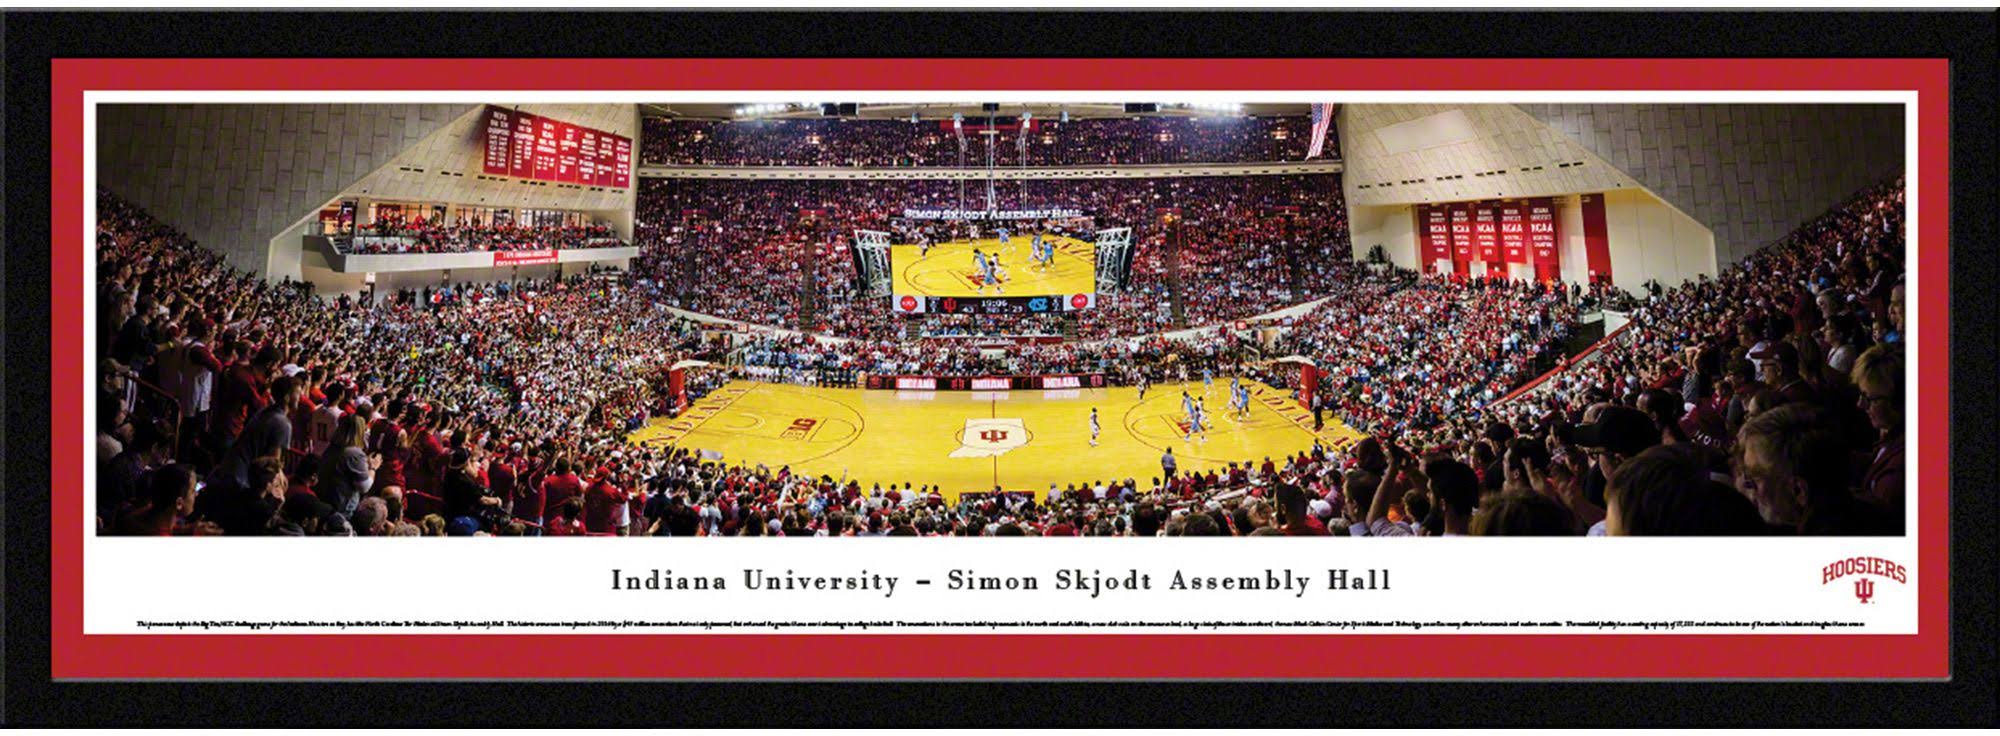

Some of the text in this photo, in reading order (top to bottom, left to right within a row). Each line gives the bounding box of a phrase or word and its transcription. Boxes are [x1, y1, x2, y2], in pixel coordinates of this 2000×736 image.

[904, 209, 941, 219] SIMON
[990, 208, 1051, 219] ASSEMBLY
[897, 377, 936, 389] INDIANA
[971, 378, 1009, 389] INDIANA
[1043, 376, 1080, 389] INDIANA
[1823, 556, 1906, 585] HOOSIERS
[612, 569, 726, 590] Indiana
[744, 569, 899, 598] University
[949, 569, 1038, 590] Simon
[1056, 569, 1151, 598] Skjodt
[1170, 569, 1310, 598] Assembly
[1329, 569, 1390, 590] Hall
